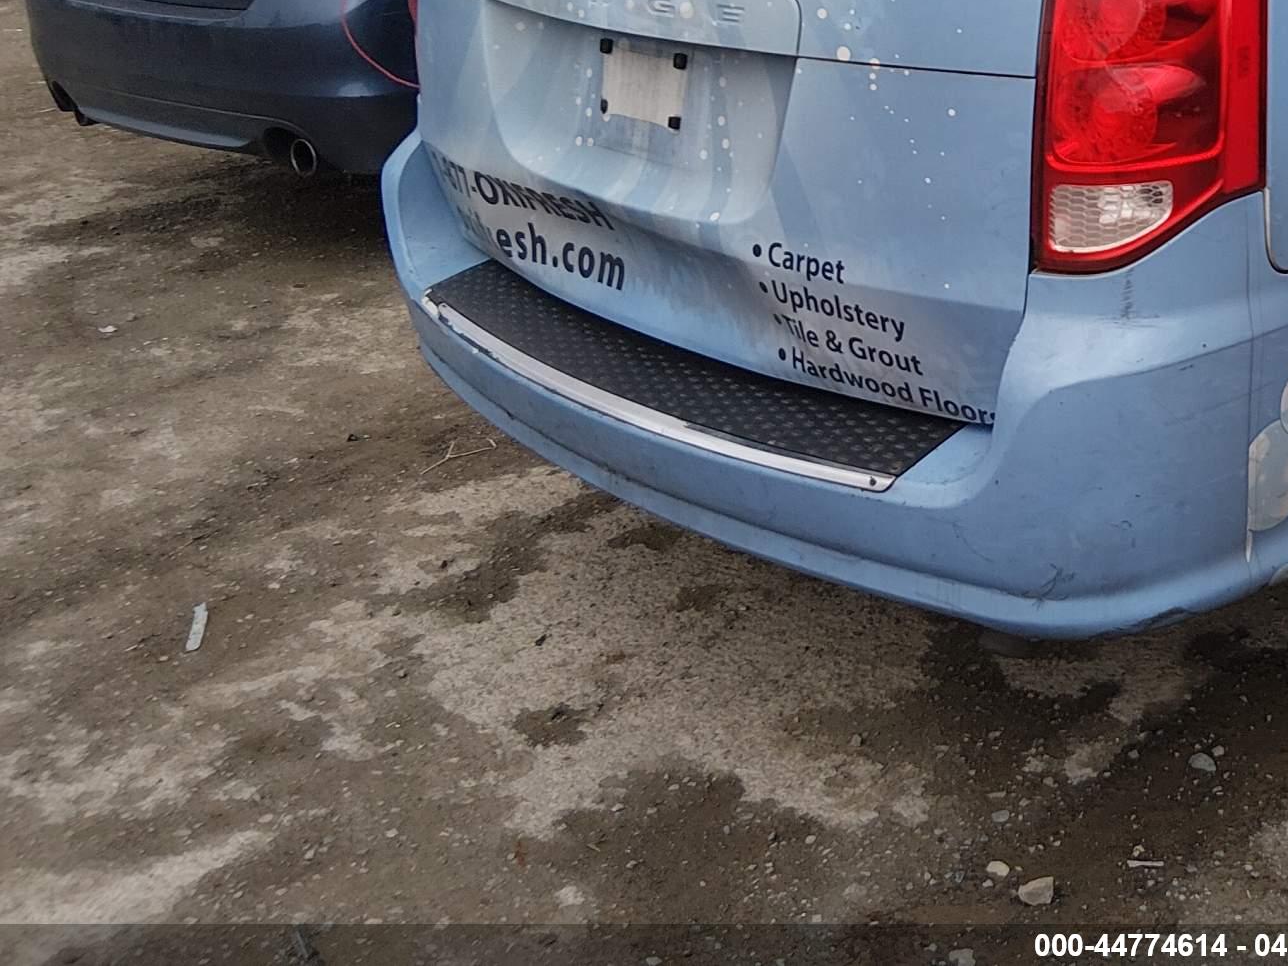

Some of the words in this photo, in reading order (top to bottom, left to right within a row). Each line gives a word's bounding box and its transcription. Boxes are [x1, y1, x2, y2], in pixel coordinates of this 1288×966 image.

[768, 242, 845, 284] Carpet
[771, 280, 905, 342] Upholstery
[782, 314, 820, 348] Tile
[825, 329, 844, 354] &
[849, 337, 924, 376] Grout
[792, 346, 914, 403] Hardwood
